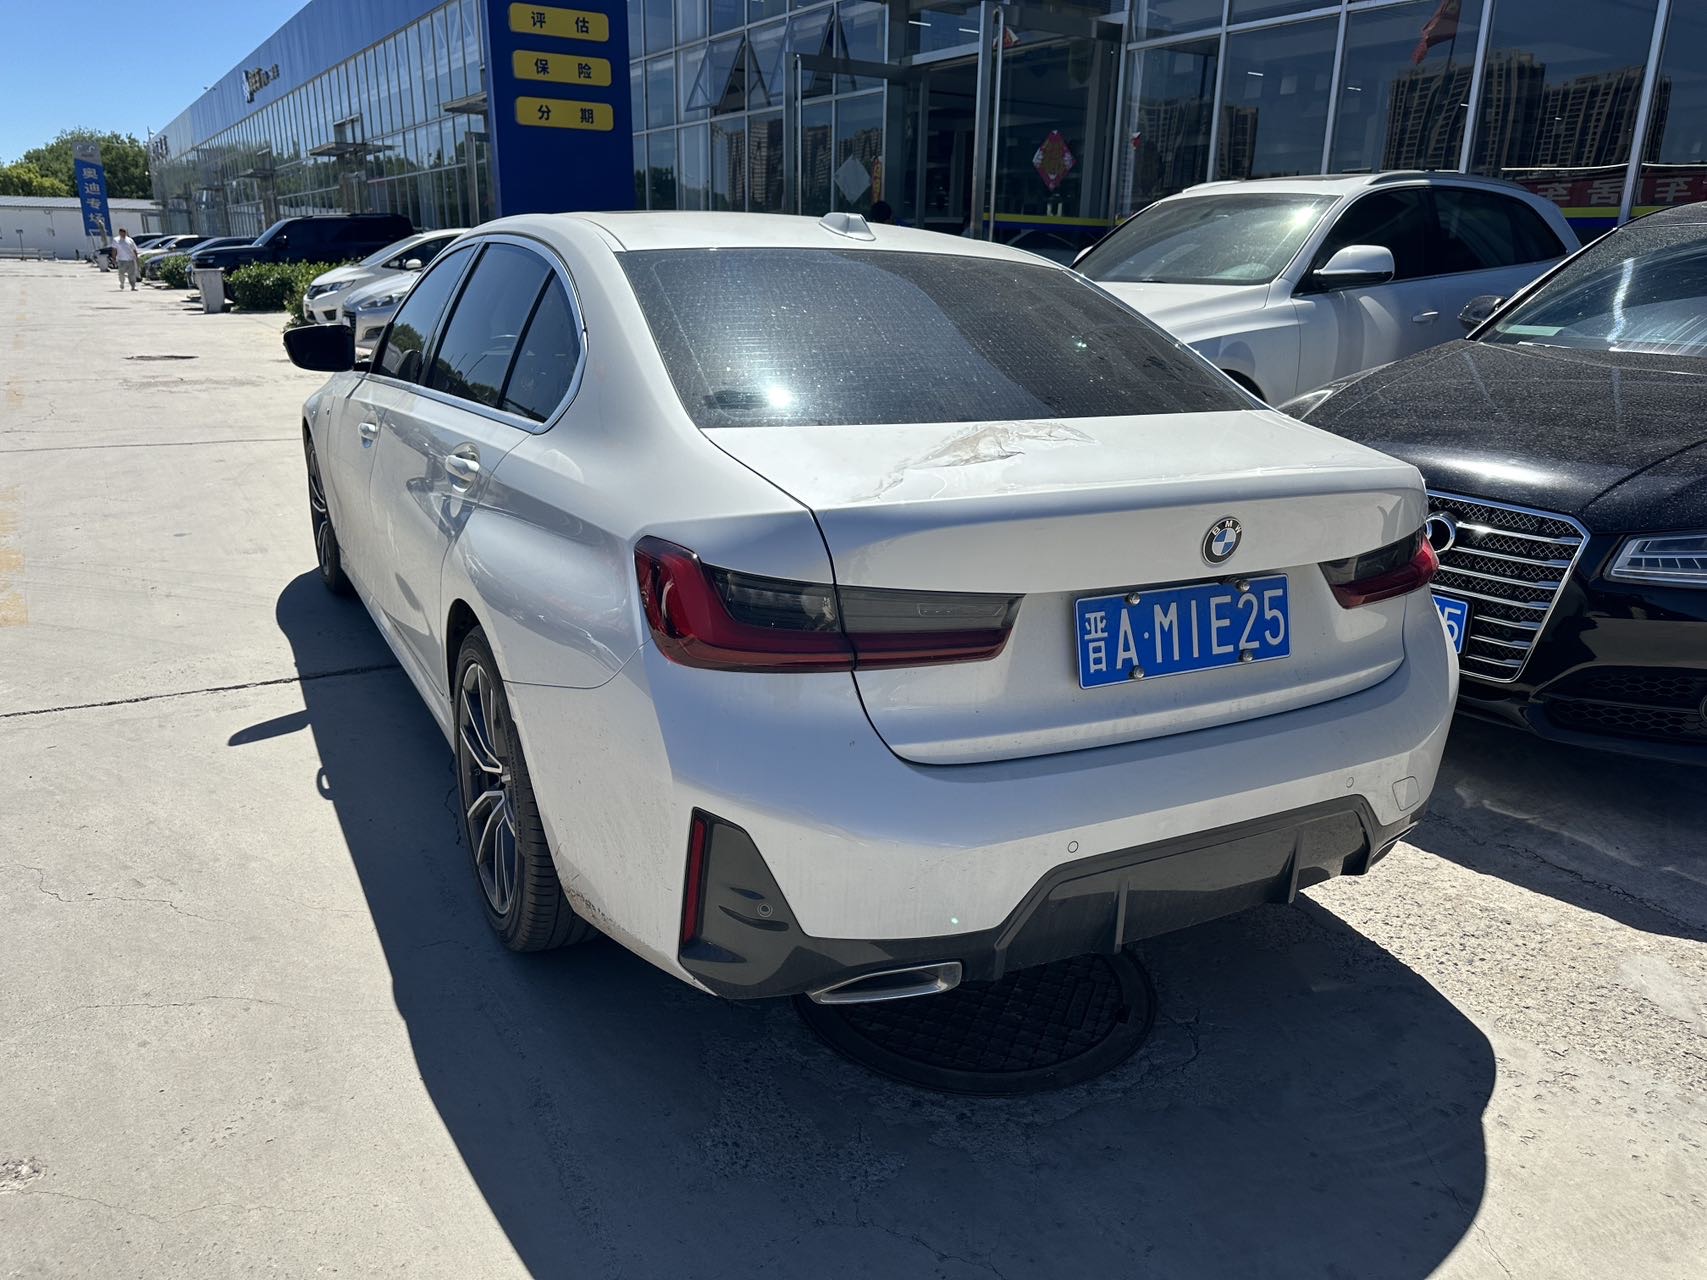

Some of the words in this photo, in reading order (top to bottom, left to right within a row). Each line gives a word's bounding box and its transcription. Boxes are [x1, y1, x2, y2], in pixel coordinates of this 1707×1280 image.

[531, 11, 590, 34] 评估
[534, 58, 592, 80] 保险
[537, 104, 594, 124] 分期
[82, 167, 106, 224] 奥迪专场
